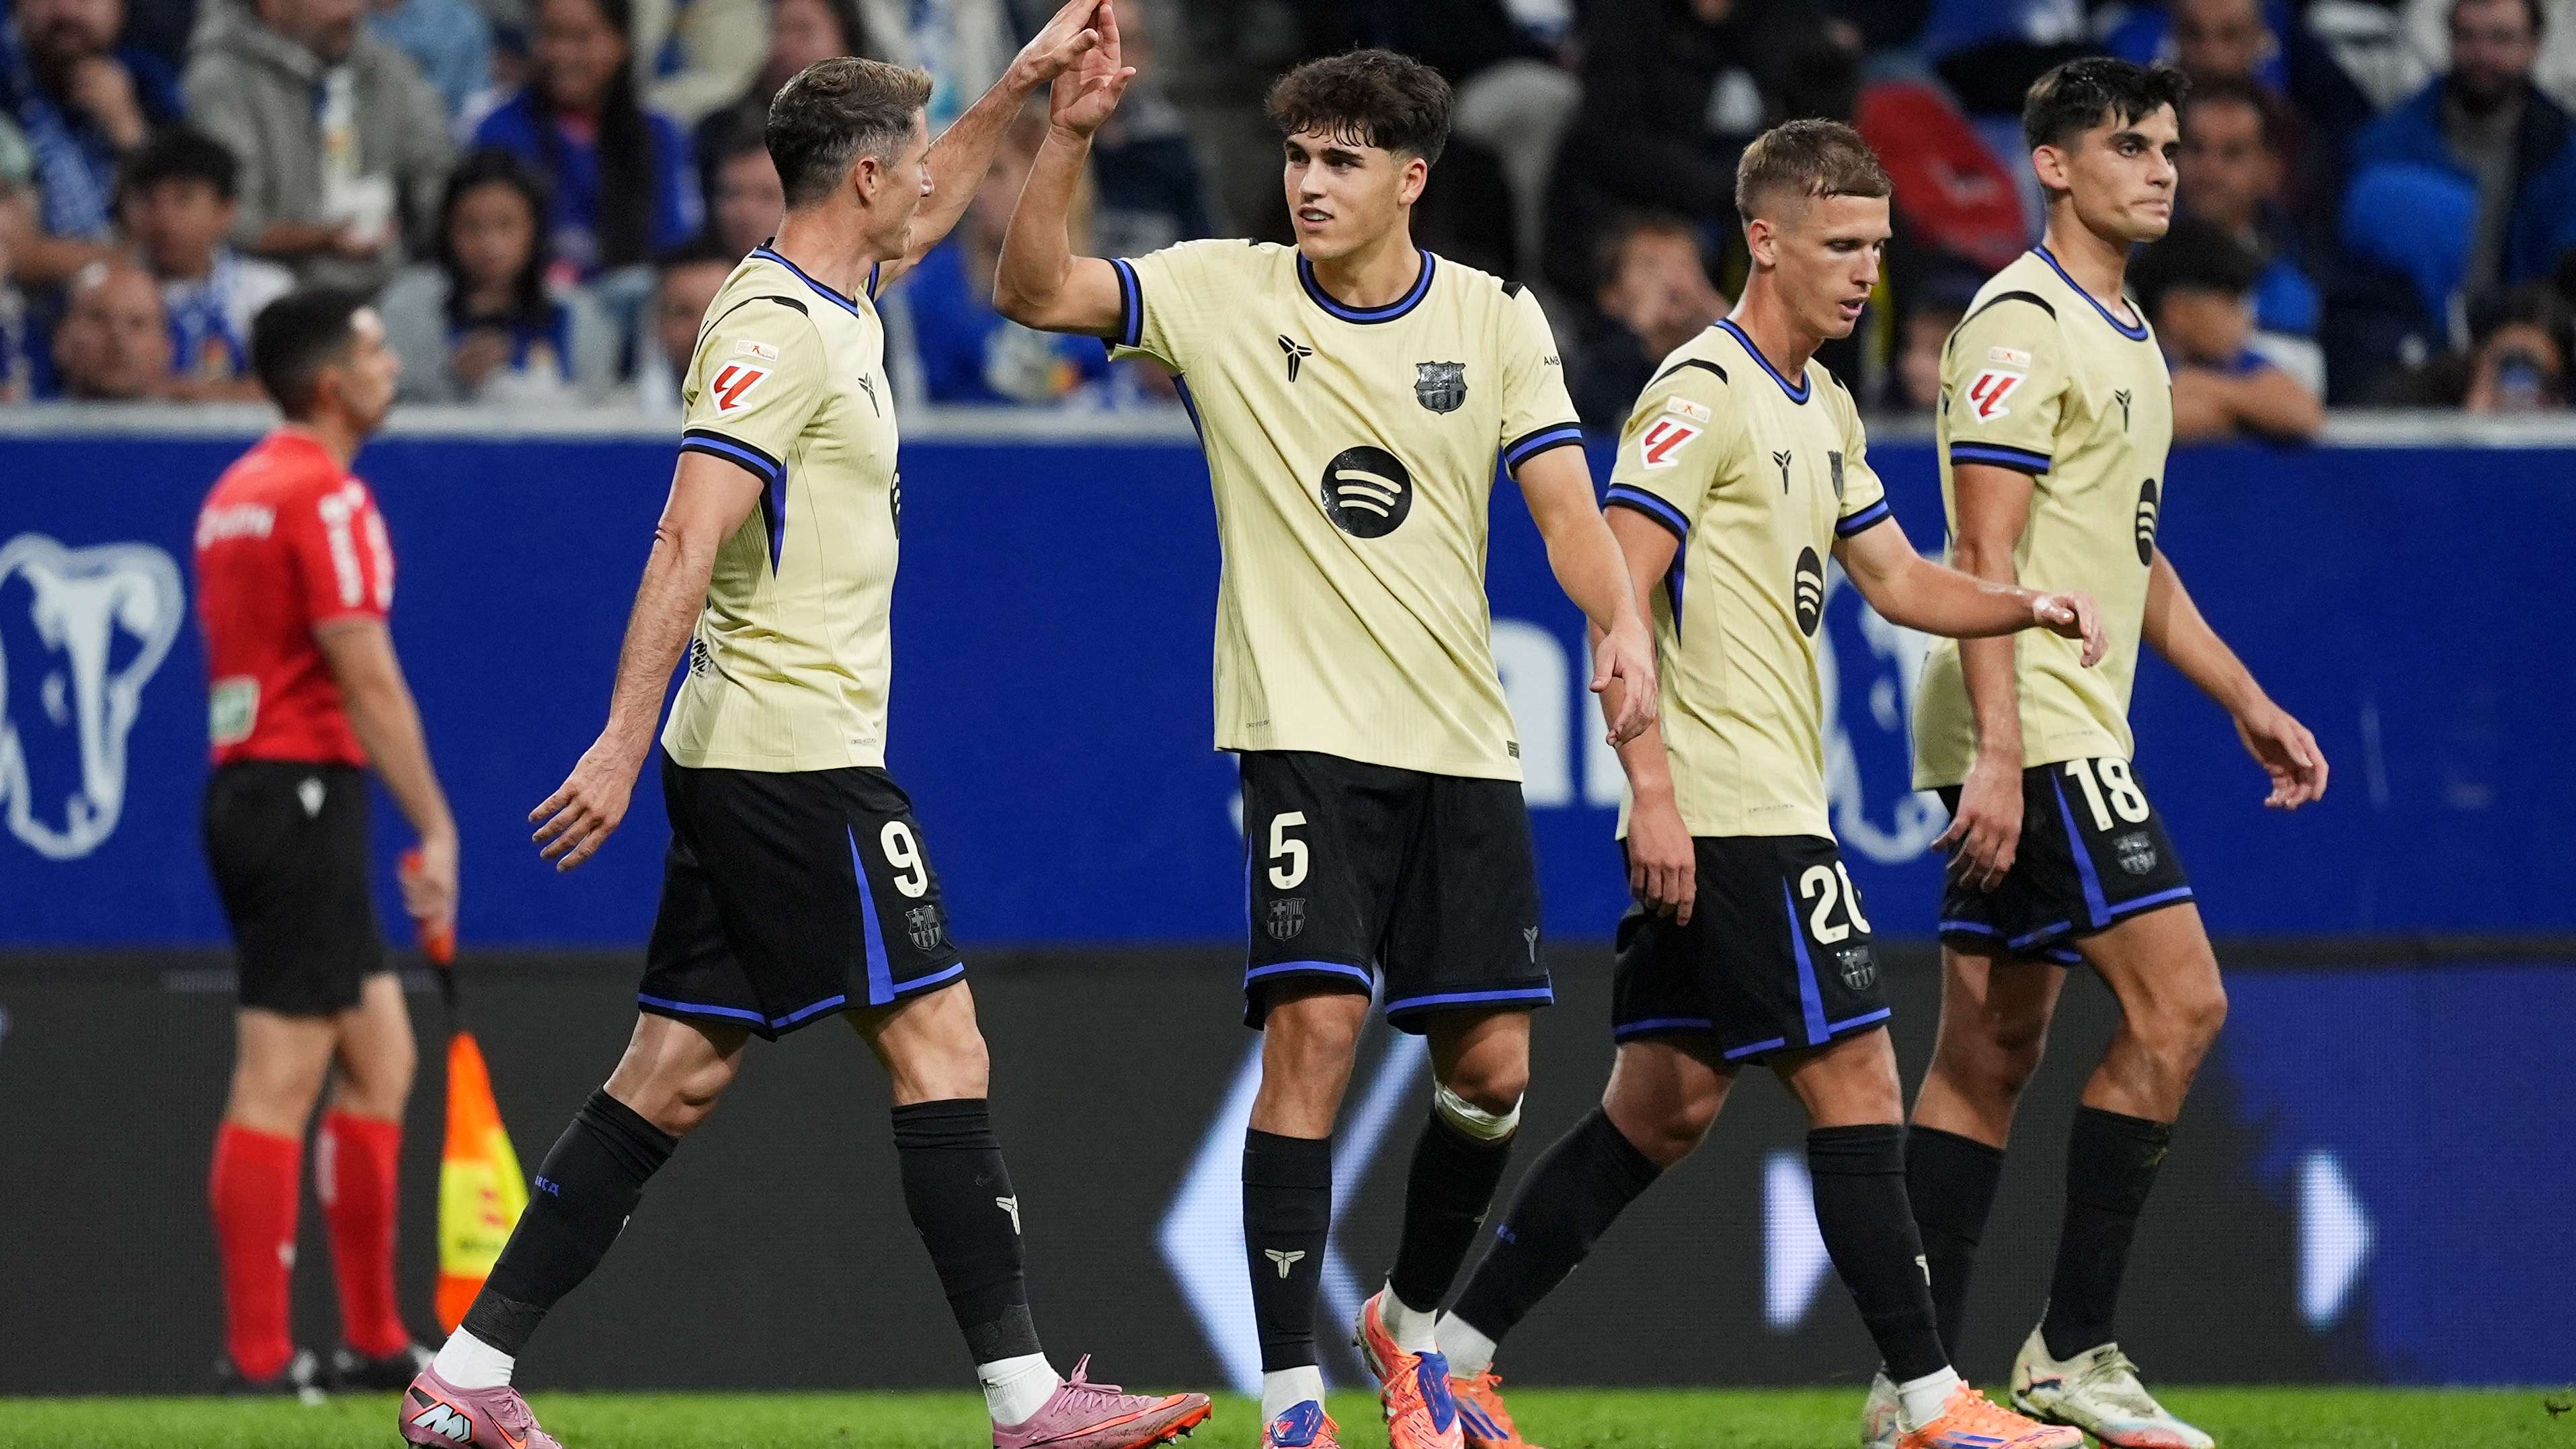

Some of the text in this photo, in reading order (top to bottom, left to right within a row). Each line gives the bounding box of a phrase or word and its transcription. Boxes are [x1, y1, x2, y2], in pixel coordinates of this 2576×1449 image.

[2065, 757, 2150, 832] 18
[881, 821, 928, 898] 9
[1269, 811, 1308, 889] 5
